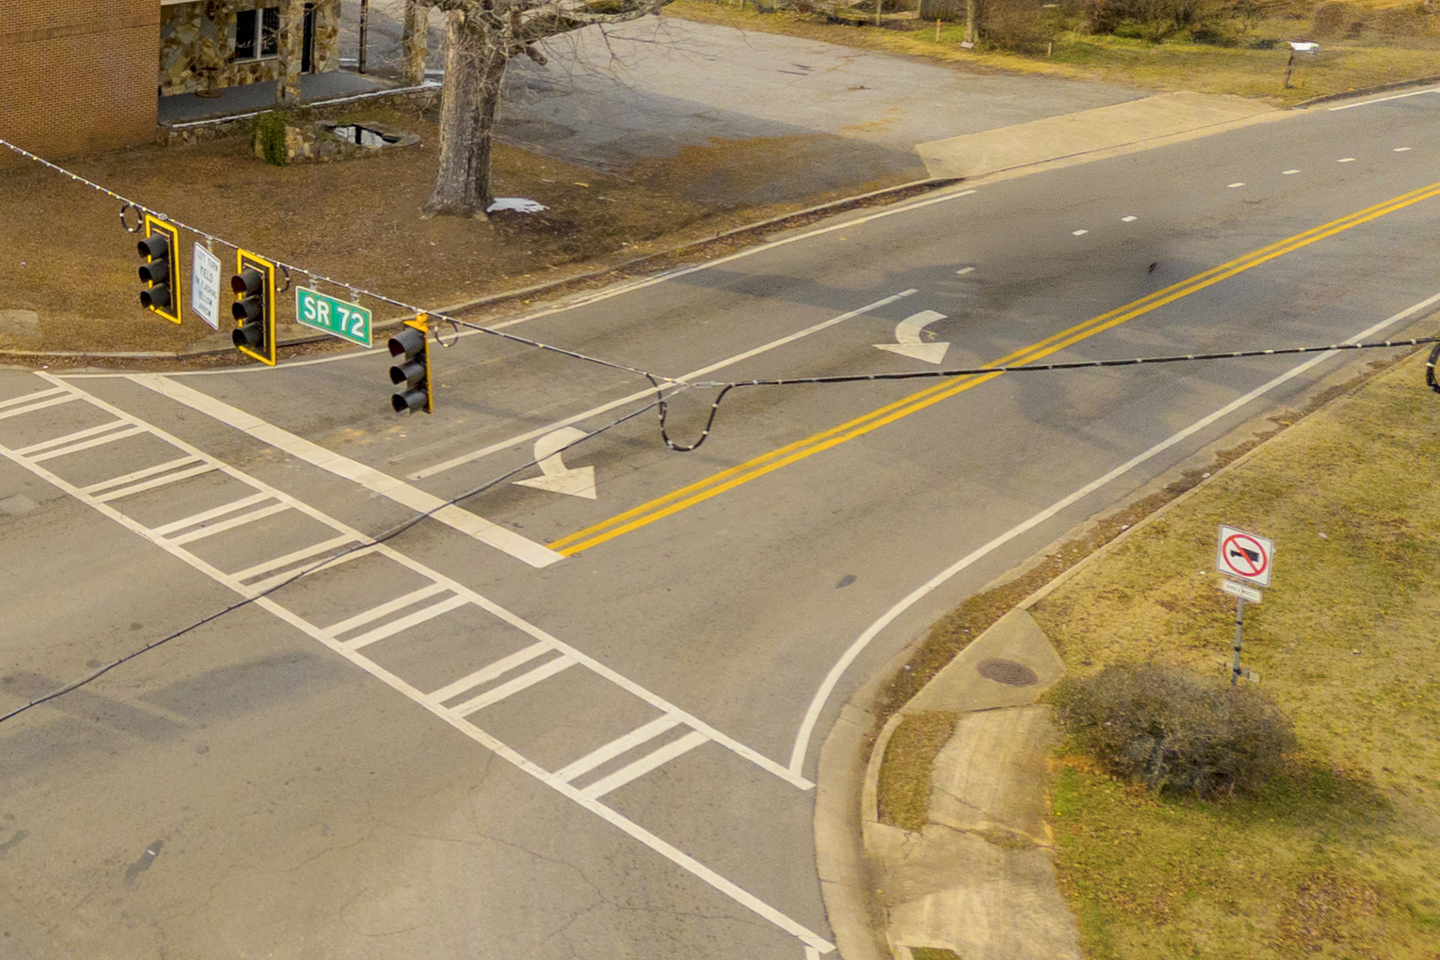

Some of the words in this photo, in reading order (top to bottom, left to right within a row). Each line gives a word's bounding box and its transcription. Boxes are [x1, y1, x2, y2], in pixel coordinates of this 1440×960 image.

[199, 265, 213, 283] YIELD
[304, 296, 330, 326] SR
[337, 307, 365, 338] 72
